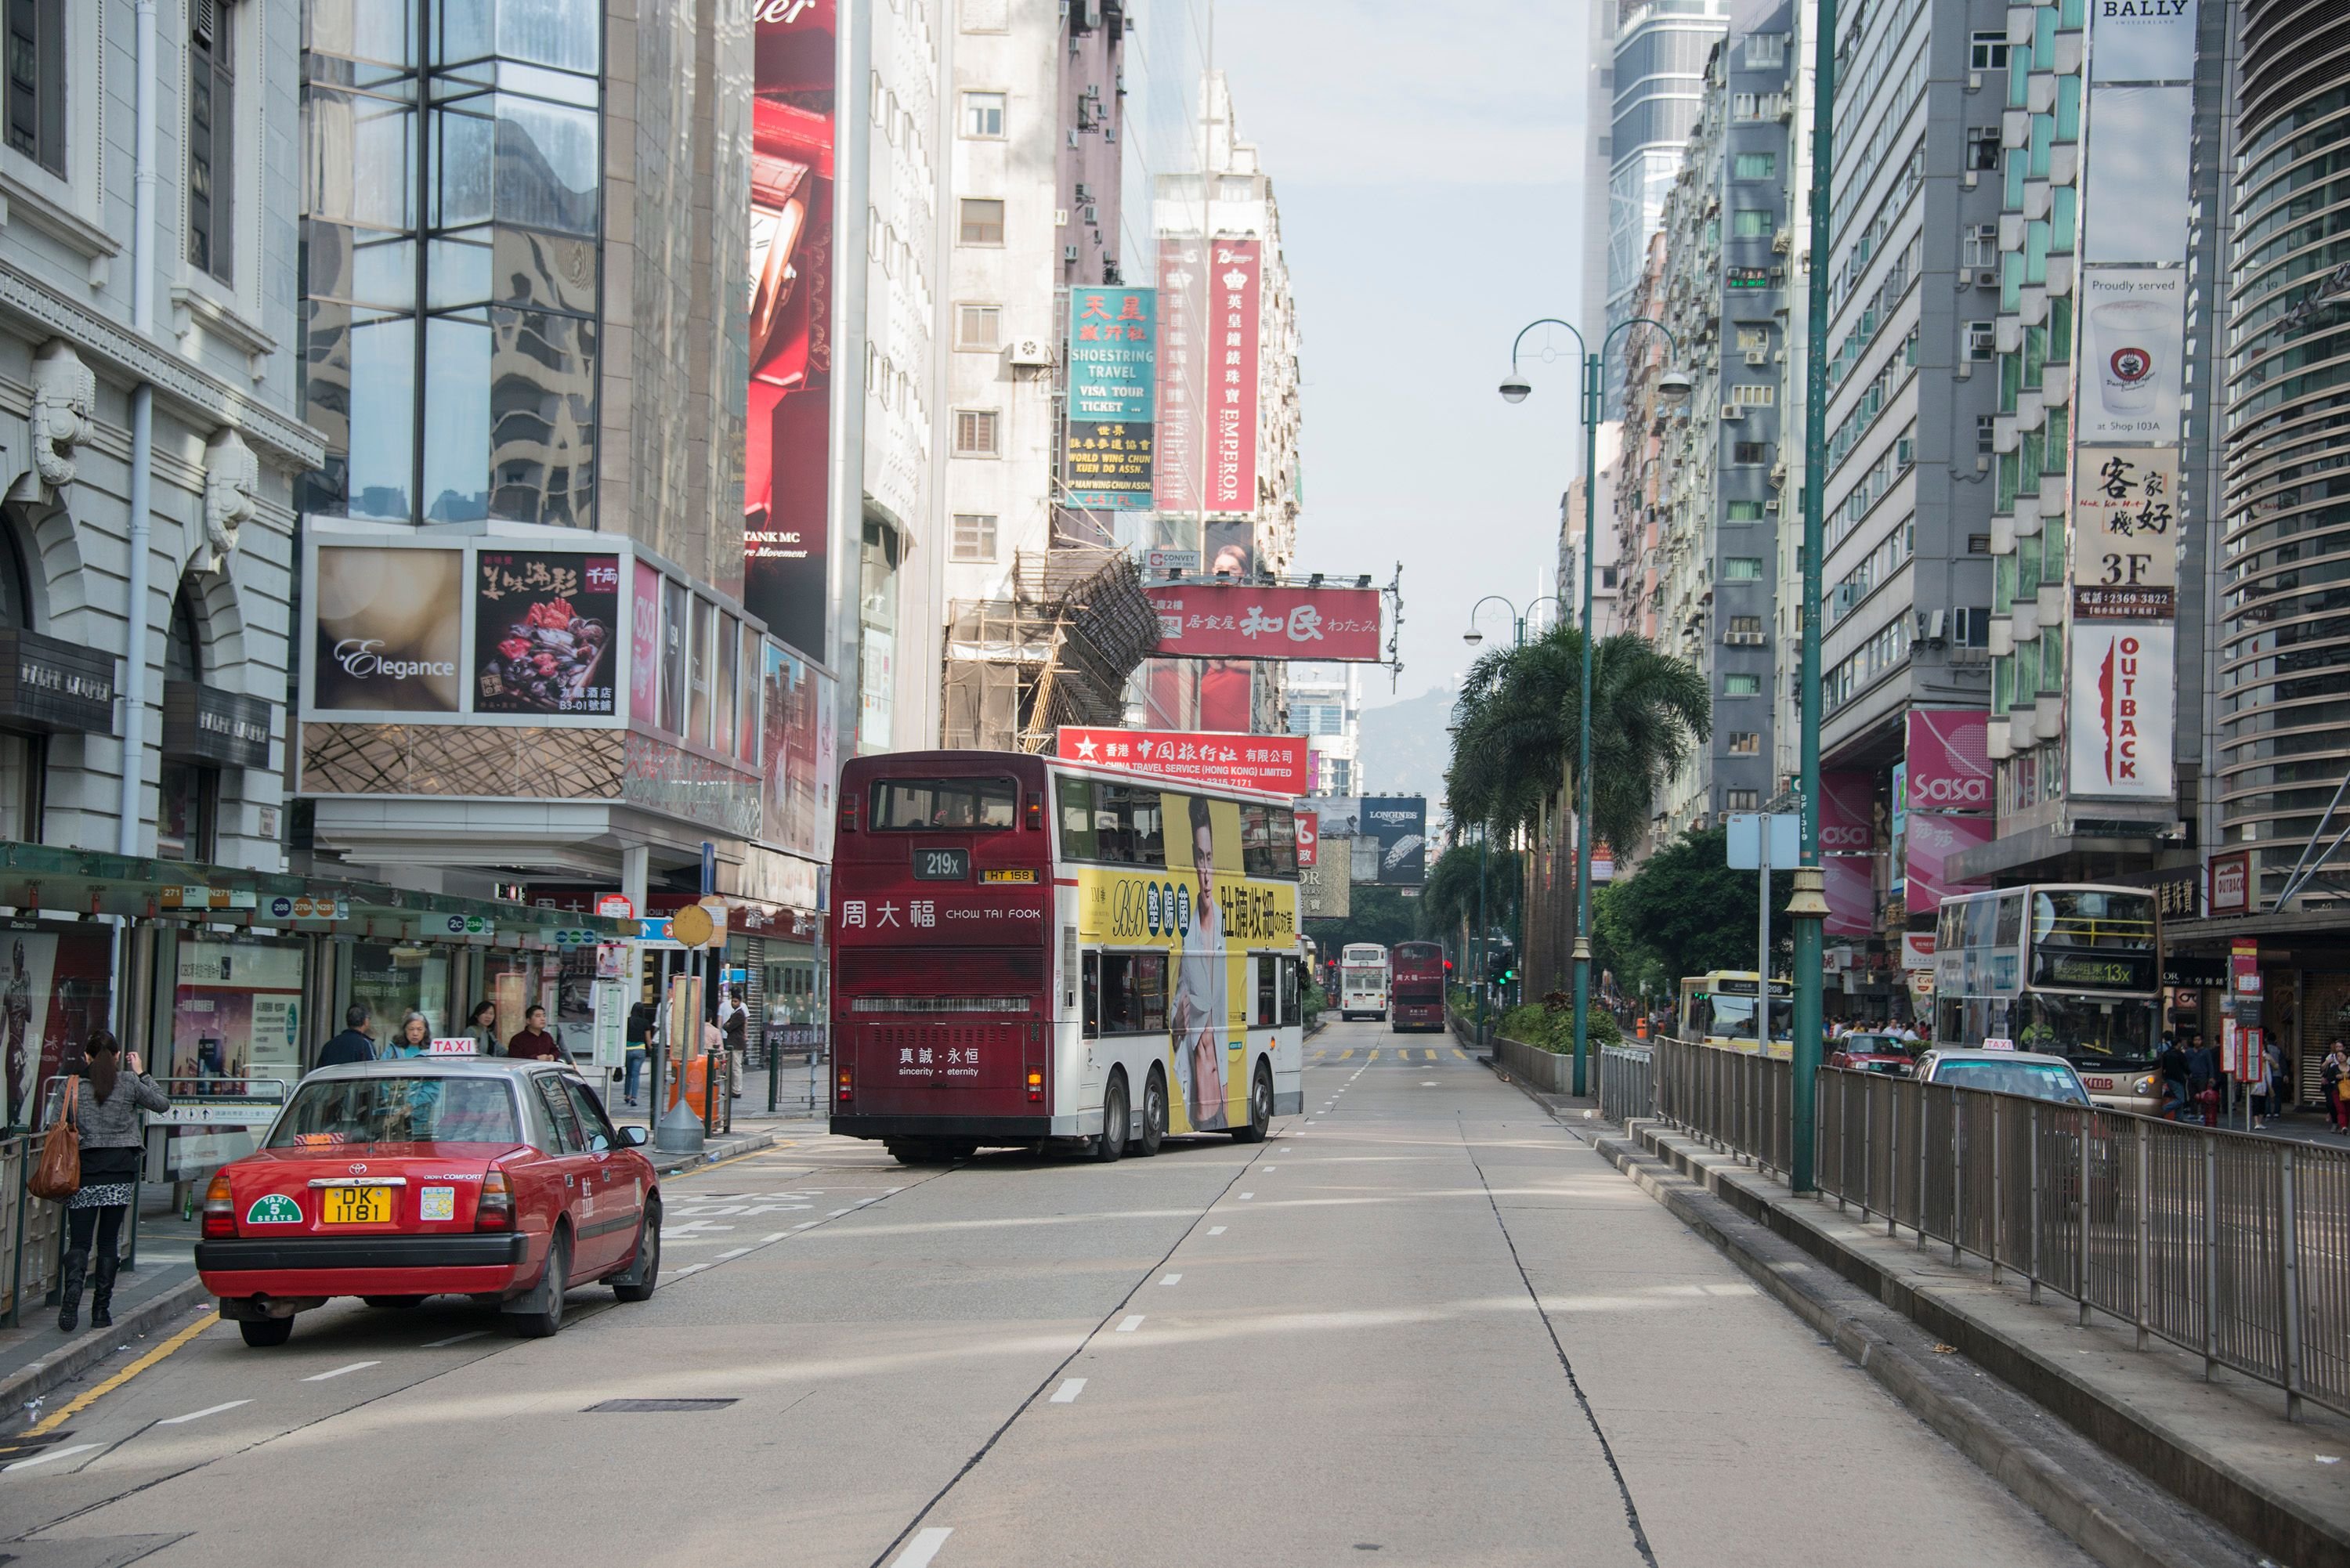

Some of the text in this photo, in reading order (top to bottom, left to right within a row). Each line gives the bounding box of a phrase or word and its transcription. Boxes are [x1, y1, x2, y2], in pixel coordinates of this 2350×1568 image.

[2103, 0, 2188, 16] BALLY
[2092, 280, 2175, 293] Proudly served
[1080, 296, 1147, 321] 天星
[1072, 349, 1154, 363] SHOESTRING
[1088, 366, 1137, 378] TRAVEL
[1079, 386, 1144, 397] VISA TOUR
[1079, 401, 1123, 412] TICKET
[1097, 425, 1126, 436] 世界
[2110, 421, 2134, 432] Shop
[2136, 421, 2160, 431] 103A
[1069, 453, 1152, 464] WORLD WING CHUN
[1223, 409, 1240, 502] EMPEROR
[1076, 464, 1144, 474] KUEN DO ASSN.
[1075, 480, 1092, 489] MAN
[1092, 481, 1112, 490] WING
[1112, 481, 1132, 490] CHUN
[743, 531, 800, 543] TANK MC
[756, 547, 808, 558] Movement
[2101, 553, 2152, 585] 3F
[2141, 594, 2168, 605] 3822
[1186, 605, 1378, 641] 居食屋 和民 わたみ
[334, 638, 455, 679] Elegance
[560, 687, 612, 698] 九龍酒店
[2119, 637, 2140, 779] OUTBACK
[1106, 743, 1130, 757] 香港
[1246, 749, 1292, 764] 有限公司
[1133, 762, 1163, 773] TRAVEL
[1166, 764, 1200, 775] SERVICE
[1202, 764, 1228, 776] (HONG
[1231, 766, 1257, 777] KONG)
[1260, 767, 1292, 777] LIMITED
[1231, 779, 1252, 787] 7171
[990, 871, 1030, 881] HT 158
[842, 901, 1041, 928] 周大福 CHOW TAI FOOK
[433, 1041, 471, 1053] TAXI
[1987, 1040, 2011, 1049] TAXI
[898, 1067, 978, 1077] sincerity eternity
[2083, 1077, 2113, 1090] KMB
[263, 1196, 287, 1205] TAXI
[343, 1188, 372, 1205] DK
[270, 1203, 280, 1215] 5
[337, 1205, 378, 1221] 1181
